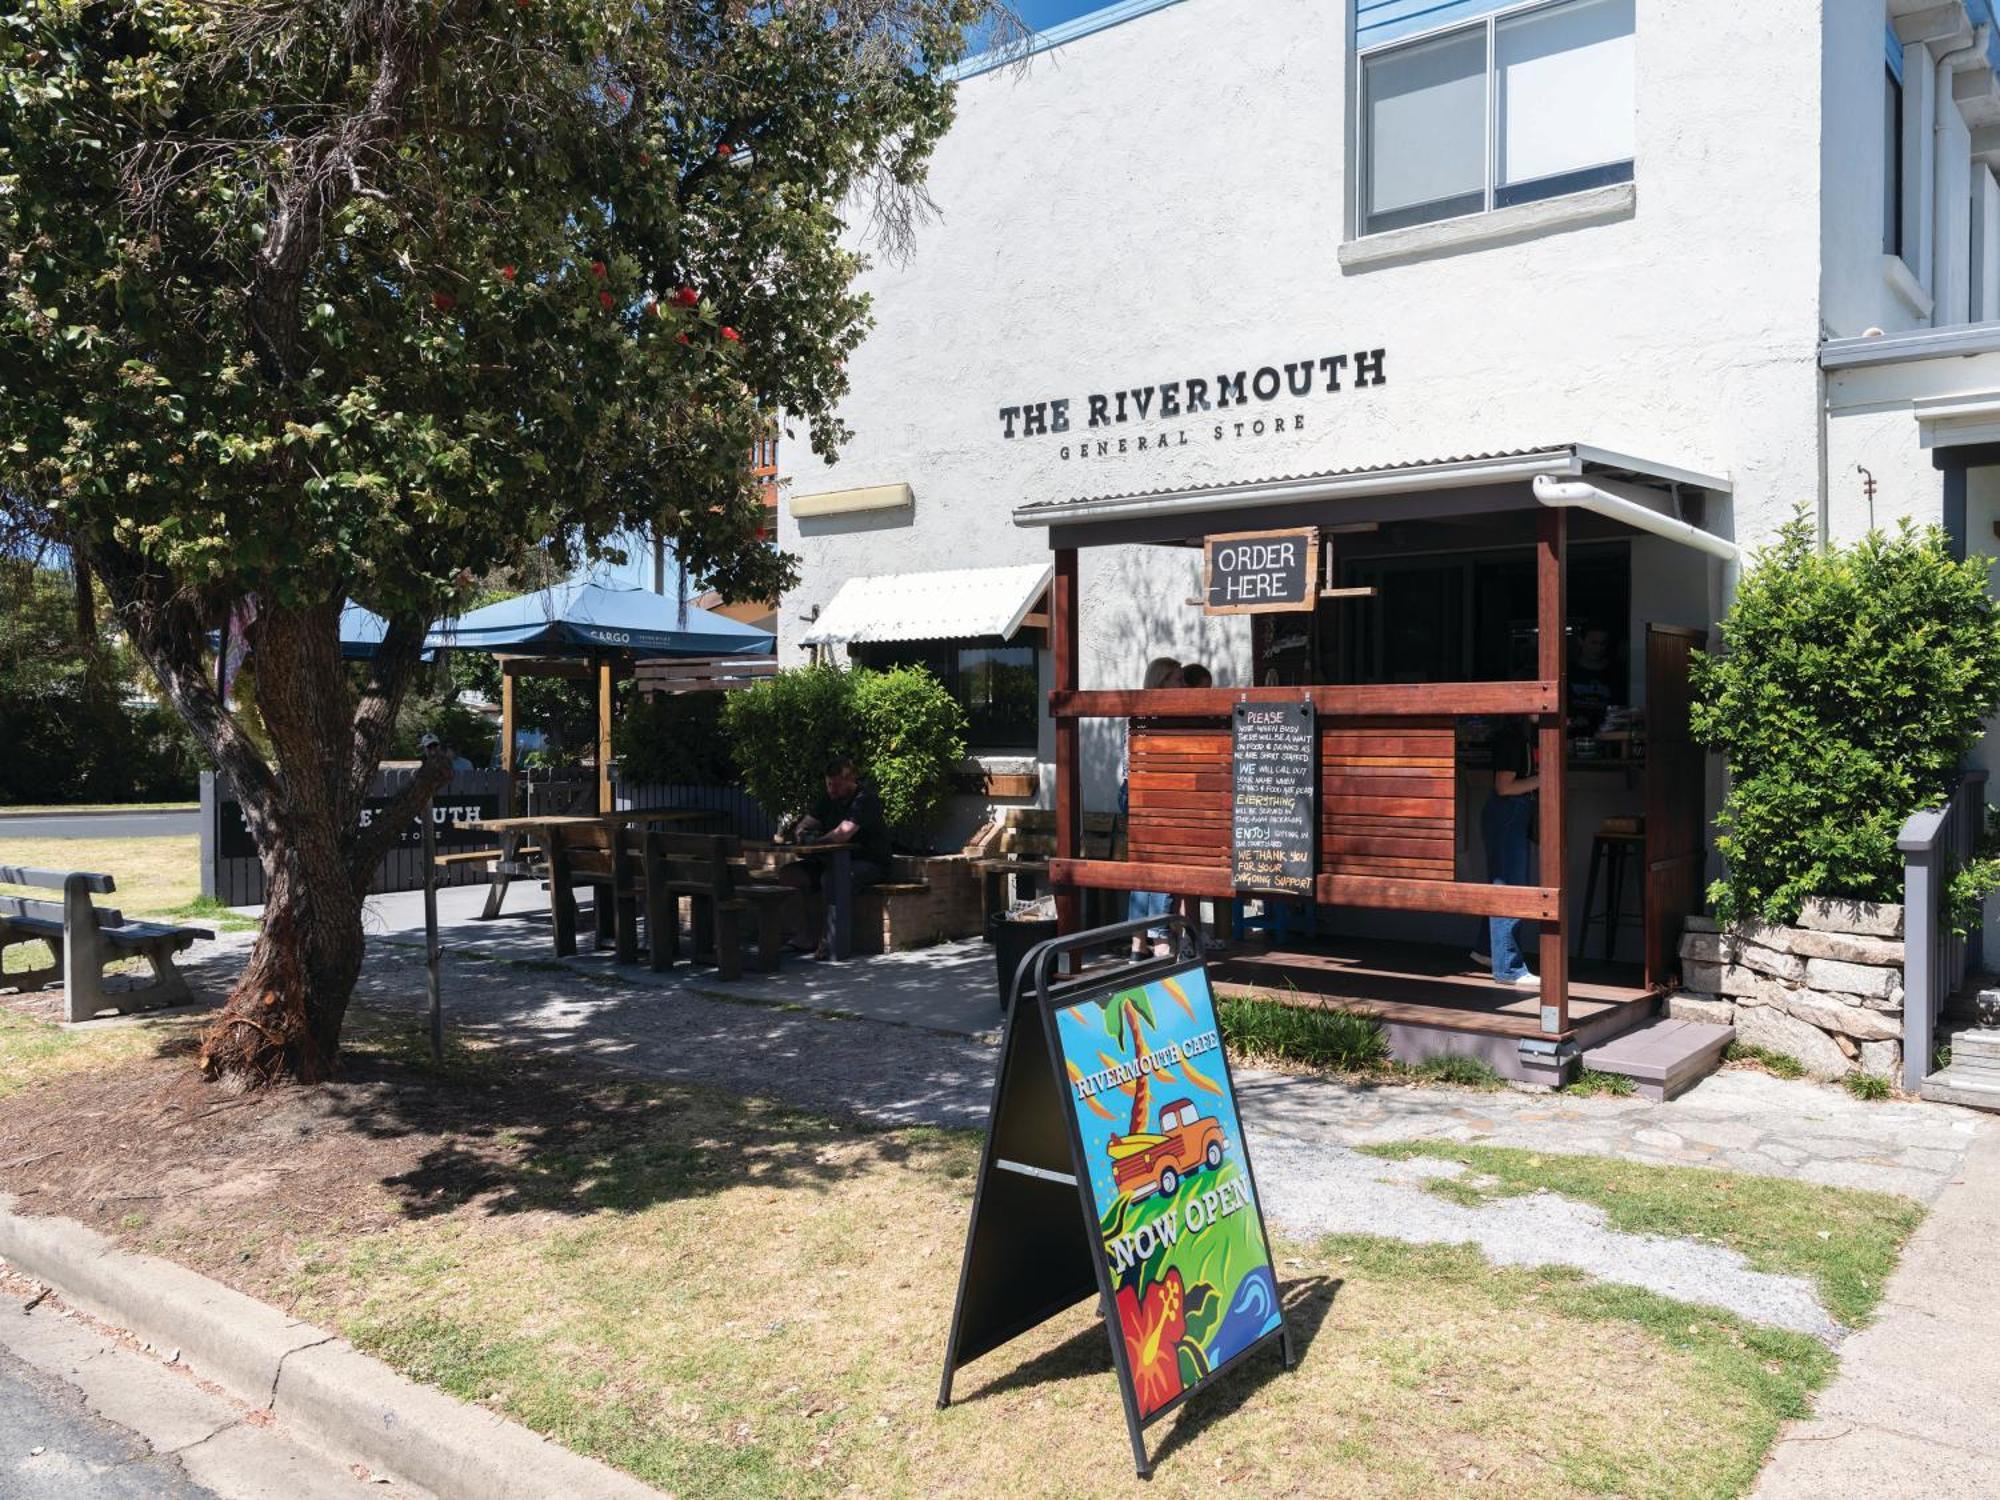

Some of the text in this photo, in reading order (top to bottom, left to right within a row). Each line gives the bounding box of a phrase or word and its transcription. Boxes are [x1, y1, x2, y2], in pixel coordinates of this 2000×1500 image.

[999, 348, 1386, 438] THE RIVERMOUTH
[1060, 414, 1305, 460] GENERAL STORE
[1218, 543, 1295, 571] ORDER
[1226, 573, 1288, 600] HERE
[590, 630, 630, 644] CARGO
[1247, 711, 1285, 724] PLEASE
[1237, 733, 1258, 742] THERE
[1259, 733, 1272, 741] WILL
[1274, 733, 1285, 741] BE
[1292, 735, 1313, 743] WAIT
[1246, 743, 1264, 751] FOOD
[1300, 745, 1311, 753] AS
[1239, 763, 1308, 776] WE WILL CALL OUT
[1236, 794, 1296, 809] EVERYTHING
[1235, 826, 1270, 840] ENJOY
[1238, 849, 1308, 862] WE THANK YOU
[1238, 861, 1282, 873] FOR YOUR
[1234, 872, 1313, 889] ONGOING SUPPORT
[1075, 1029, 1220, 1100] RIVERMOUTH CAFE
[1110, 1176, 1250, 1275] NOW OPEN
